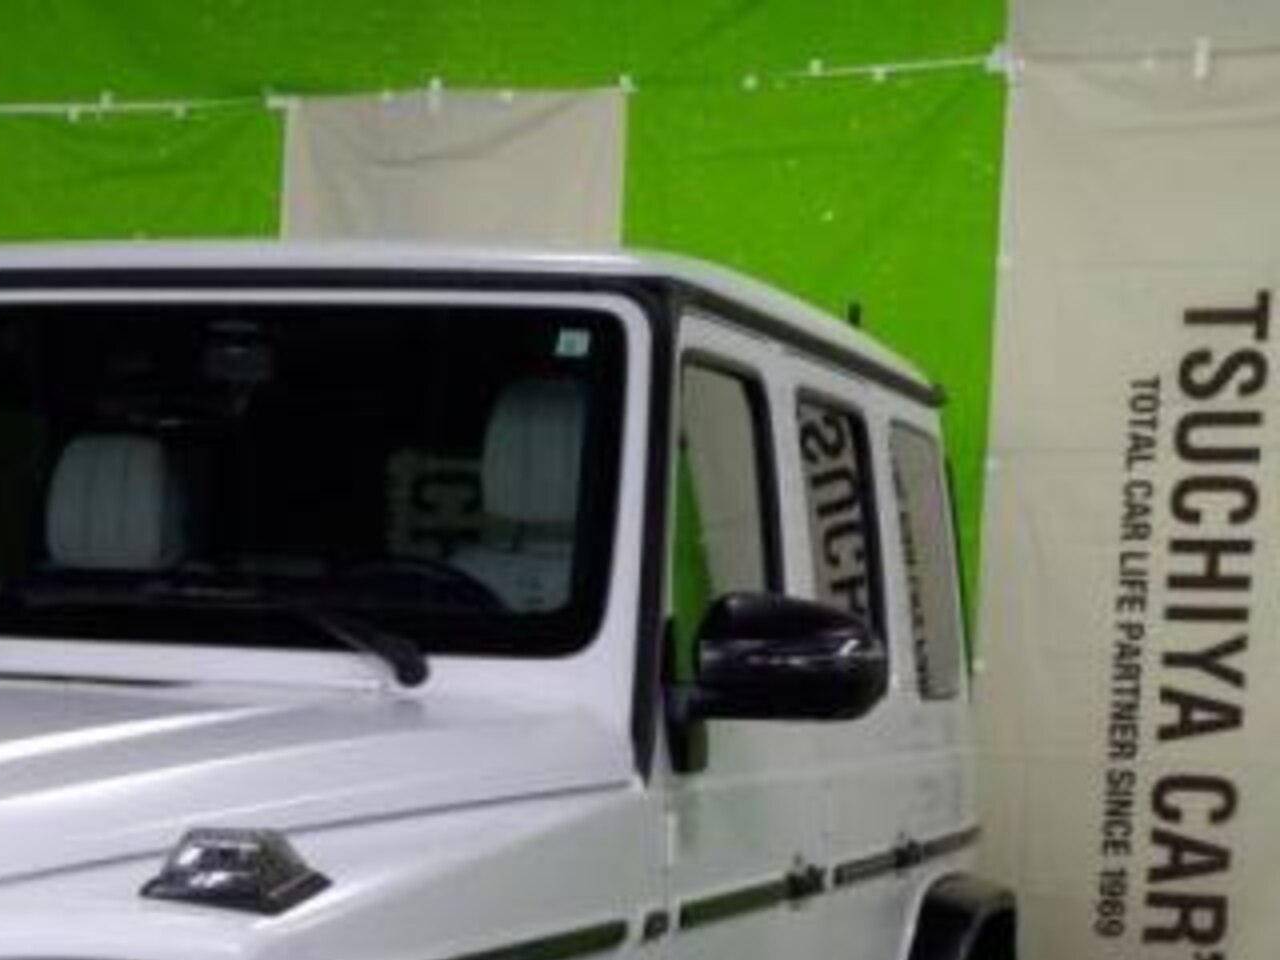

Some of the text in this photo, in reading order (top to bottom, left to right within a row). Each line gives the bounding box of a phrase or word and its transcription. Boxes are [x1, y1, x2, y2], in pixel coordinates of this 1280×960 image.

[1124, 374, 1161, 471] TOTAL
[1120, 479, 1153, 541] CAR
[1155, 289, 1271, 742] TSUCHIYA
[1115, 551, 1149, 612] LIFE
[1107, 621, 1145, 760] PARTNER
[1102, 768, 1136, 856] SINCE
